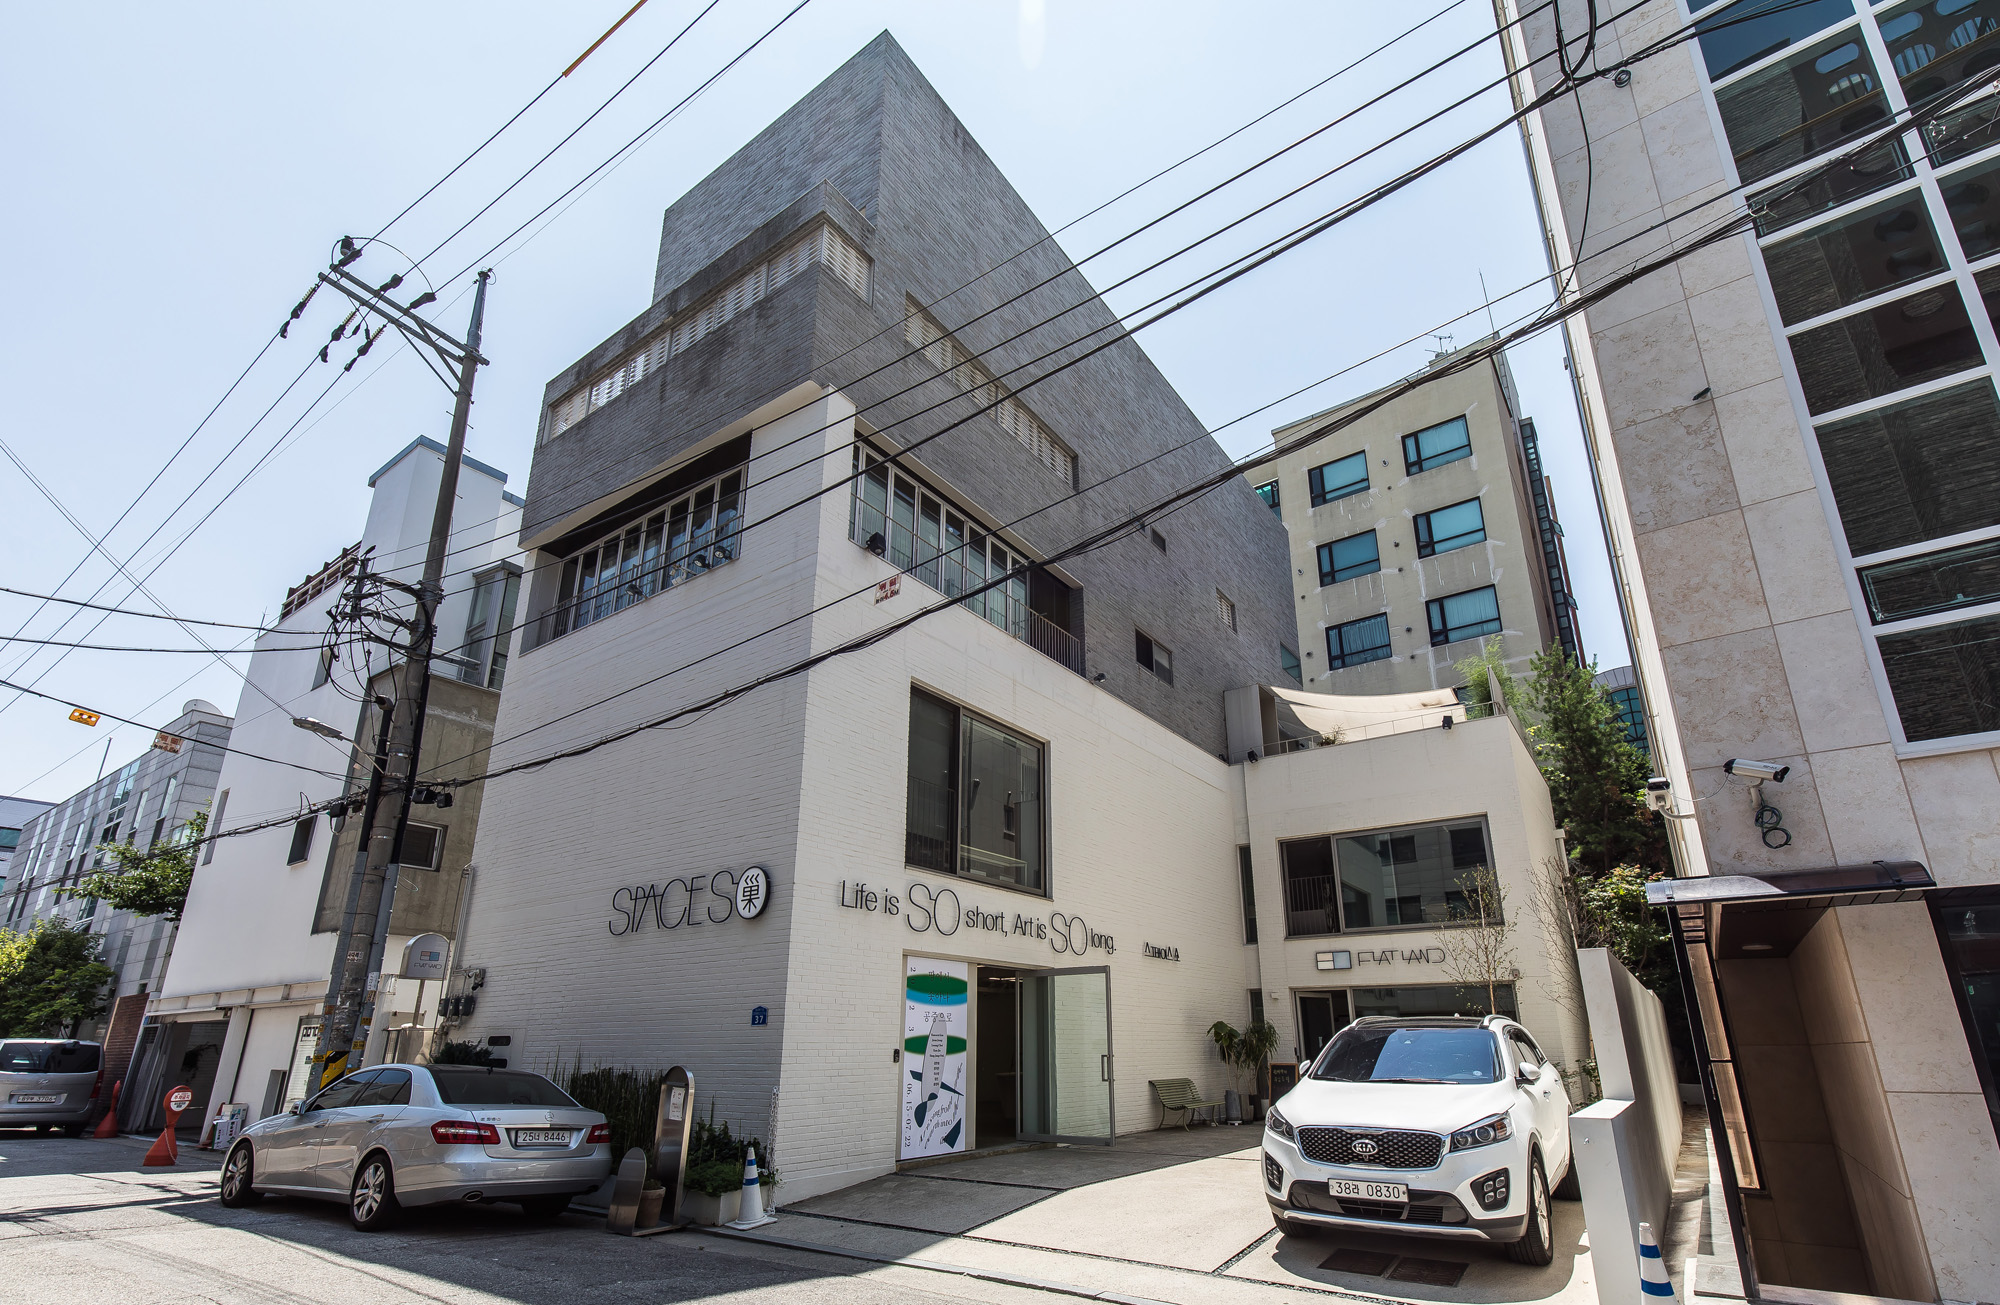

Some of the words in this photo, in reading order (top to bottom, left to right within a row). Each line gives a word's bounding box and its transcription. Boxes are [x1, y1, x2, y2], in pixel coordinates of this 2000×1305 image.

[609, 875, 706, 936] SPACE
[840, 880, 878, 912] Life
[884, 888, 900, 915] is
[907, 883, 961, 936] SO
[965, 905, 1008, 937] short,
[1013, 913, 1034, 937] Art
[1036, 917, 1047, 940] is
[1050, 912, 1088, 956] SO
[1090, 927, 1117, 955] long.
[754, 1015, 764, 1024] 37
[923, 1011, 953, 1023] 공중으로
[543, 1131, 566, 1142] 8446
[1355, 1143, 1373, 1152] KIA
[1335, 1181, 1360, 1195] 38라
[1366, 1184, 1400, 1199] 0830
